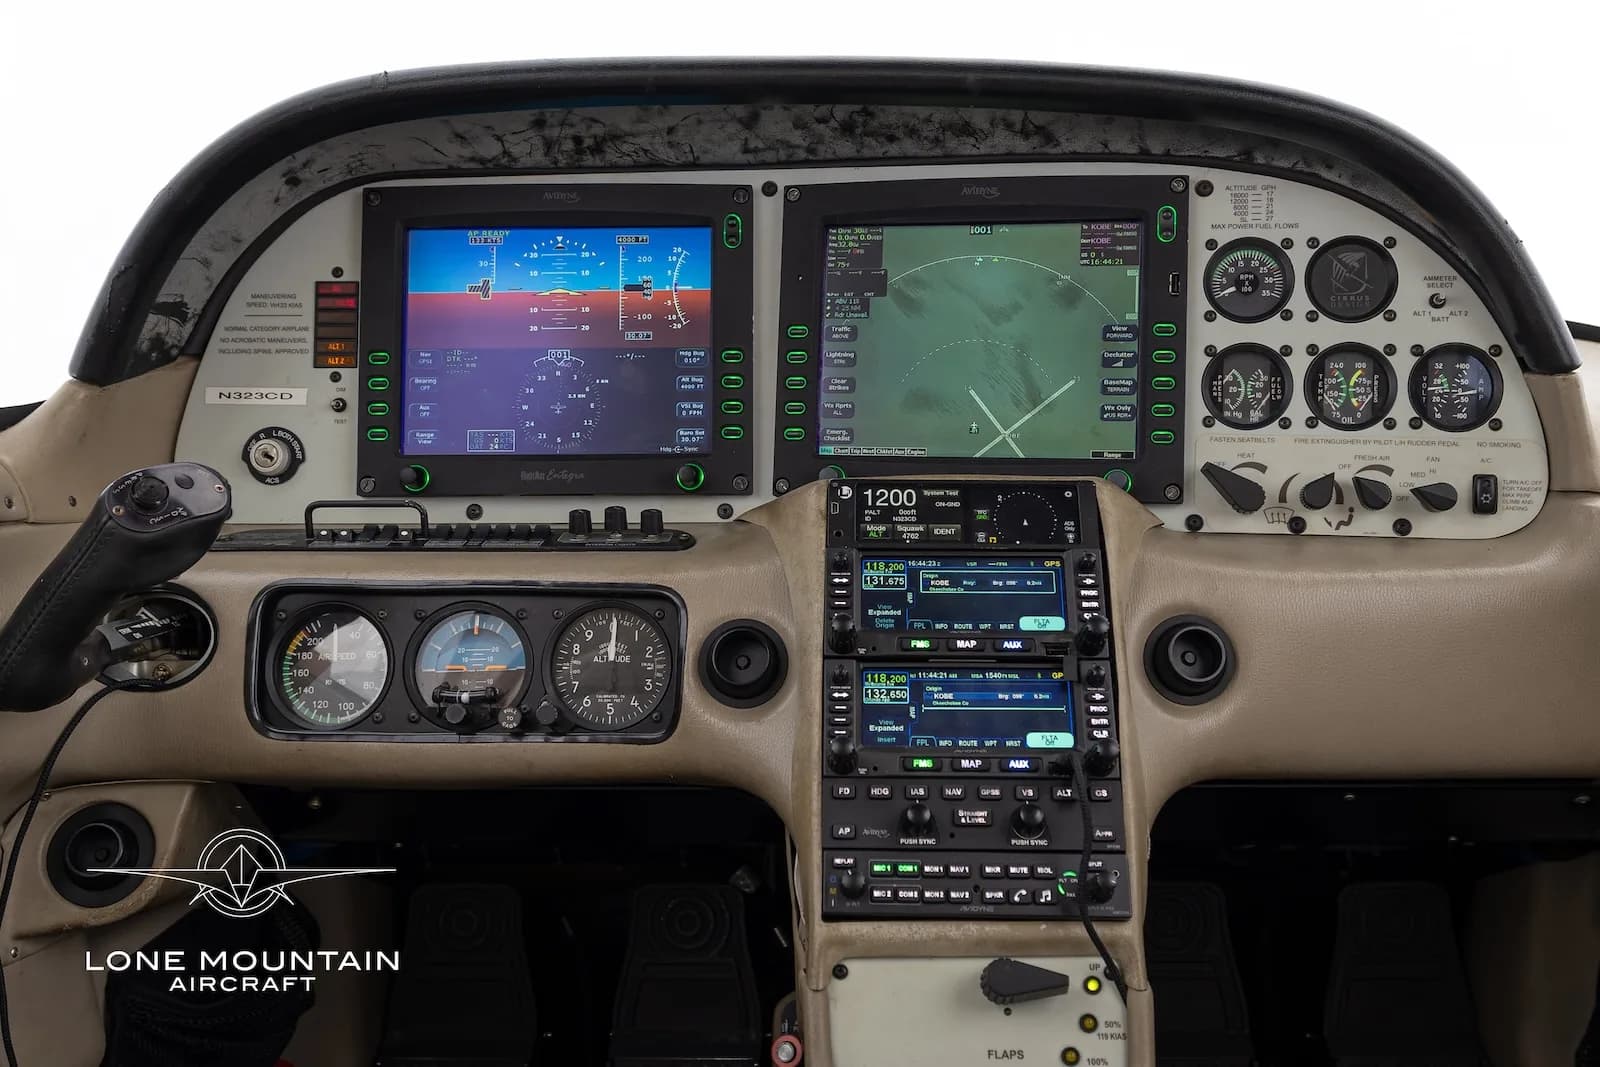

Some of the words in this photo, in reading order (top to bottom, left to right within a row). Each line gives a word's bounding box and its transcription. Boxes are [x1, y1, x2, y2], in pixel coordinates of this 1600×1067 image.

[328, 357, 339, 365] ALT
[218, 391, 293, 400] N323CD
[1209, 436, 1236, 444] FASTEN
[1310, 438, 1362, 446] EXTINGUISHER
[863, 488, 917, 507] 1200
[897, 525, 925, 533] Squawk
[865, 562, 905, 571] 118.200
[866, 577, 905, 586] 131.675
[868, 609, 902, 617] Expanded
[584, 629, 594, 642] 9
[635, 630, 638, 642] 1
[306, 637, 324, 646] 200
[910, 640, 930, 648] FMS
[956, 640, 977, 648] MAP
[1002, 641, 1022, 649] AUX
[572, 643, 580, 655] 8
[645, 646, 653, 658] 2
[296, 652, 313, 660] 180
[318, 652, 356, 660] AIRPEED
[593, 655, 631, 663] ALTUDE
[292, 669, 309, 677] 160
[866, 673, 906, 683] 118.200
[363, 681, 374, 690] 80
[571, 681, 579, 693] 7
[644, 679, 653, 691] 3
[298, 686, 314, 694] 140
[866, 688, 907, 699] 132.650
[312, 700, 329, 709] 120
[582, 695, 592, 707] 6
[630, 695, 639, 707] 4
[338, 702, 355, 711] 100
[606, 703, 615, 715] 5
[913, 759, 933, 768] FMS
[960, 759, 982, 768] MAP
[1009, 759, 1030, 769] AUX
[838, 787, 850, 795] FD
[870, 787, 889, 795] HDG
[910, 787, 925, 795] IAS
[945, 788, 962, 796] NAV
[1056, 789, 1072, 797] ALT
[1095, 789, 1108, 797] GS
[838, 827, 851, 835] AP
[873, 864, 887, 872] MIC
[898, 864, 914, 872] COM
[1009, 866, 1029, 874] MUTE
[873, 890, 887, 898] MIC
[898, 890, 914, 898] COM
[950, 891, 965, 899] NAV
[1089, 963, 1101, 971] UP
[1104, 1021, 1121, 1029] 50%
[1097, 1033, 1109, 1041] 119
[1110, 1033, 1127, 1041] KIAS
[987, 1049, 1025, 1061] FLAPS
[1087, 1058, 1109, 1066] 100%
